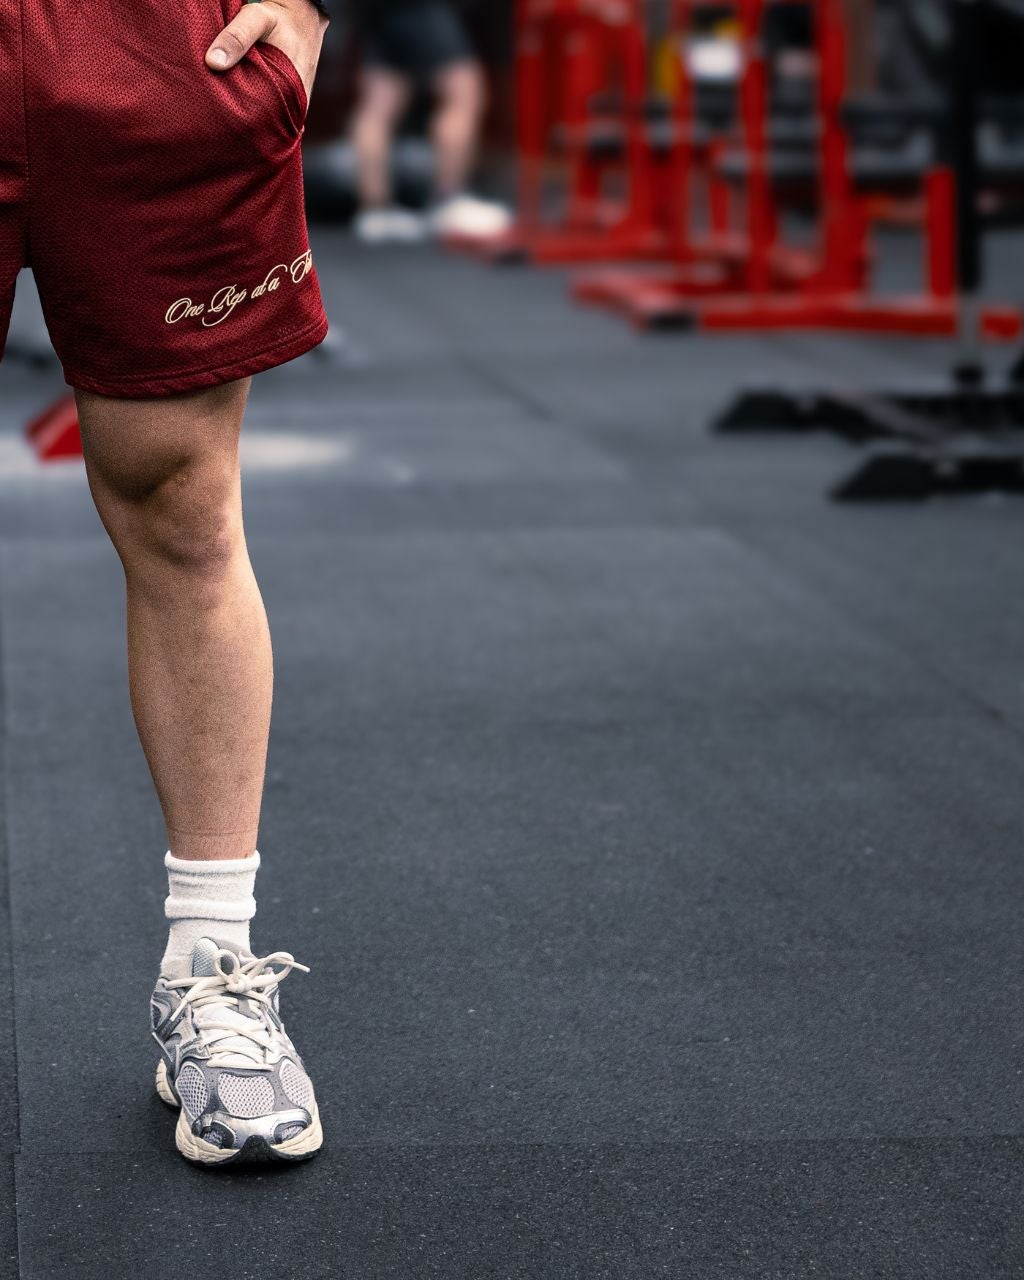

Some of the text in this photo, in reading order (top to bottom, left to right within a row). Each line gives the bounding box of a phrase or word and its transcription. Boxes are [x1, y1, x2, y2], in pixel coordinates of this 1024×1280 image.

[165, 297, 205, 324] One
[202, 284, 247, 327] Rep
[267, 276, 280, 292] a
